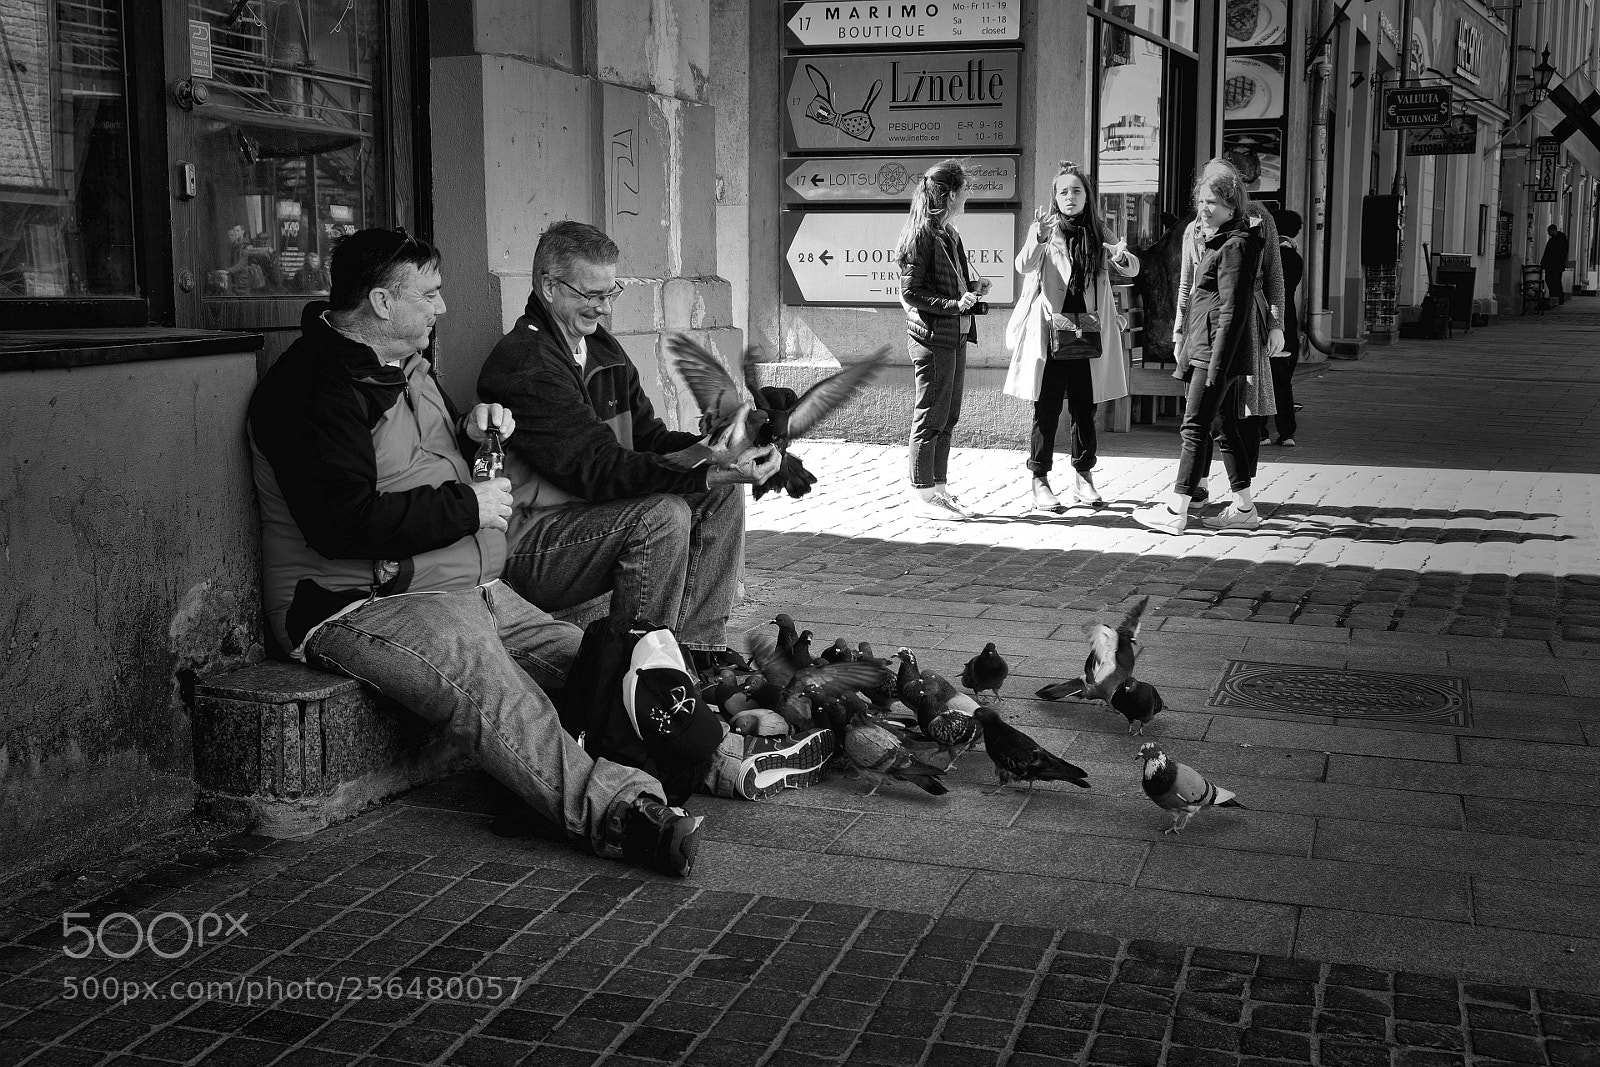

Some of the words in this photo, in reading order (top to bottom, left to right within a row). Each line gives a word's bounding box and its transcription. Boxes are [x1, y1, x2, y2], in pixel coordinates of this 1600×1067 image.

[971, 2, 979, 10] Fr
[982, 2, 990, 10] 11
[998, 1, 1007, 9] 19
[825, 4, 939, 20] MARIMO
[799, 17, 812, 31] 17
[953, 16, 962, 24] Sa
[998, 15, 1007, 23] 18
[838, 25, 925, 38] BOUTIQUE
[952, 27, 962, 35] Su
[981, 27, 1006, 35] closed
[889, 58, 1004, 103] Linette
[1397, 94, 1439, 104] VALUUTA
[1396, 114, 1439, 124] EXCHANGE
[888, 122, 941, 131] PESUPOOD
[957, 121, 974, 130] E-R
[979, 120, 985, 128] 9
[993, 120, 1004, 129] 18
[957, 132, 963, 140] L
[975, 132, 985, 140] 10
[993, 132, 1004, 140] 16
[1543, 158, 1552, 188] BAAR
[795, 175, 807, 186] 17
[829, 173, 877, 186] LOITSU
[798, 252, 814, 263] 28
[845, 250, 897, 263] LOOD
